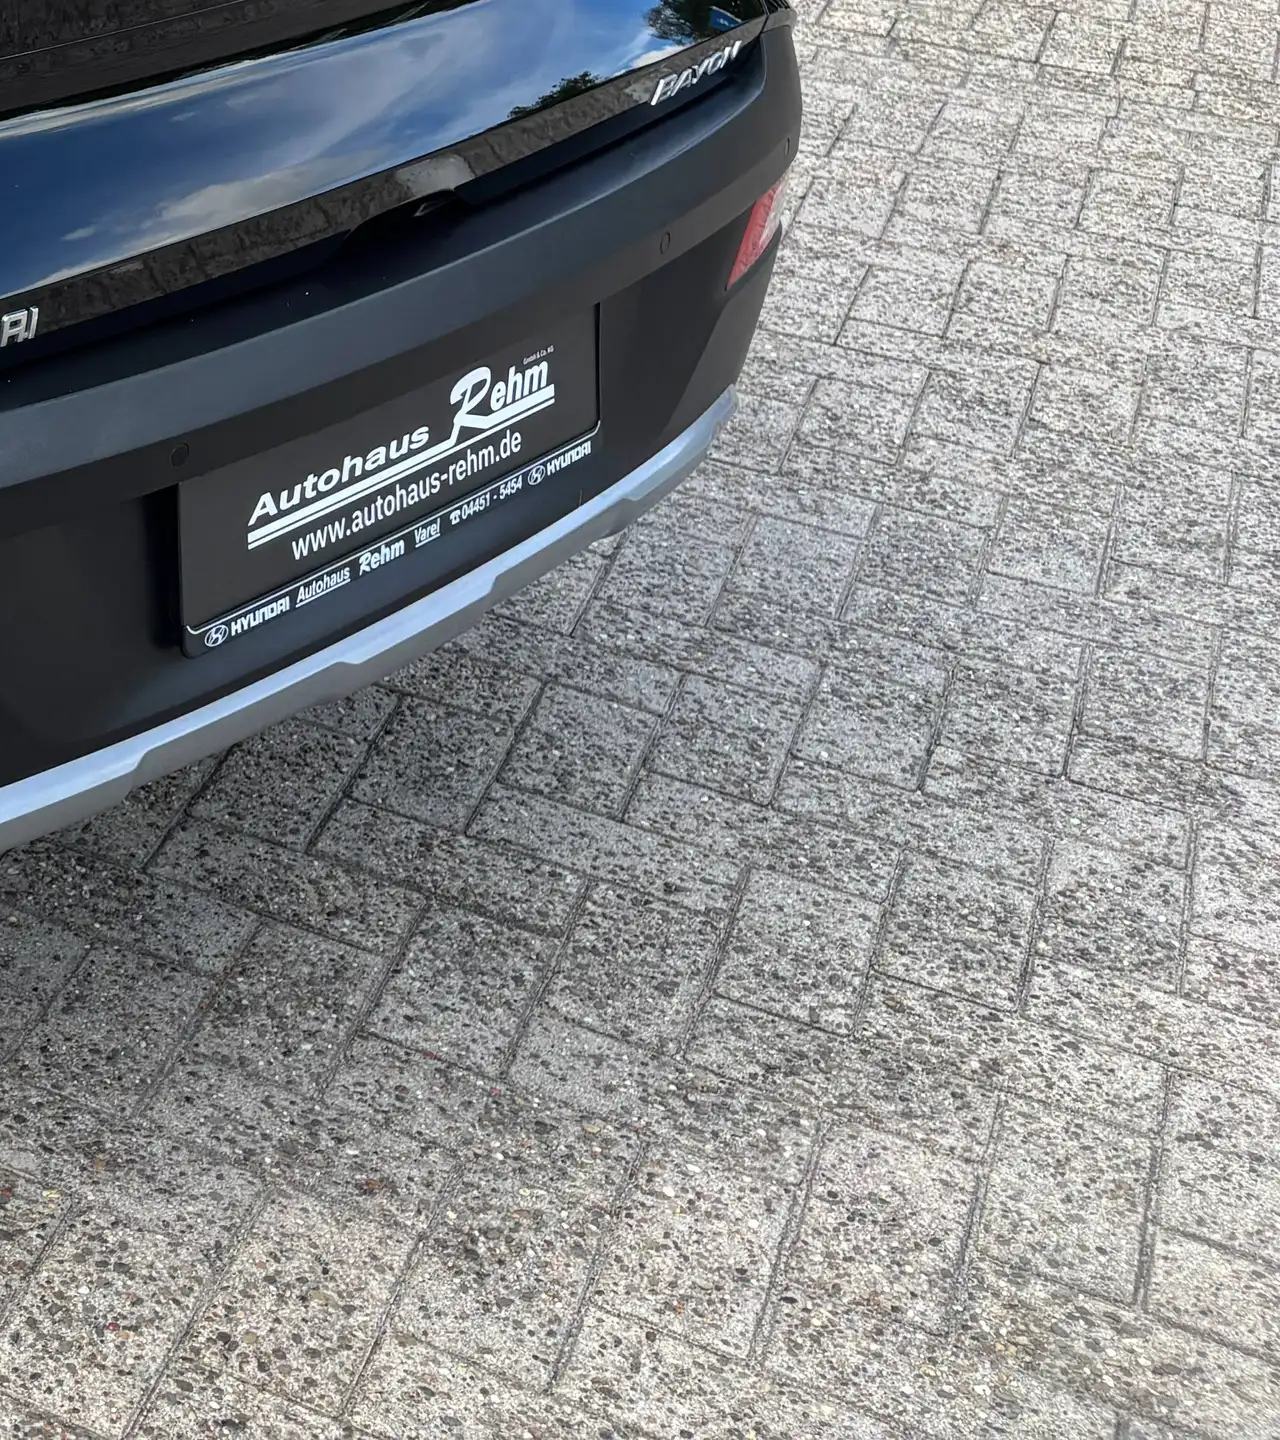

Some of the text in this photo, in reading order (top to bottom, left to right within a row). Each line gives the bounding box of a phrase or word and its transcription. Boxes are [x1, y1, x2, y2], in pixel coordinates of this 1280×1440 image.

[650, 40, 743, 106] BAYON
[247, 360, 550, 527] Autohaus Rehm
[291, 429, 522, 560] www.autohaus-rehm.de
[230, 596, 290, 636] HYUNDAI
[296, 567, 350, 603] Autohaus
[358, 539, 405, 575] Rehm
[414, 518, 440, 544] Varel
[461, 492, 490, 520] 04451
[499, 475, 522, 500] 5454
[547, 440, 591, 476] HYUNDAI
